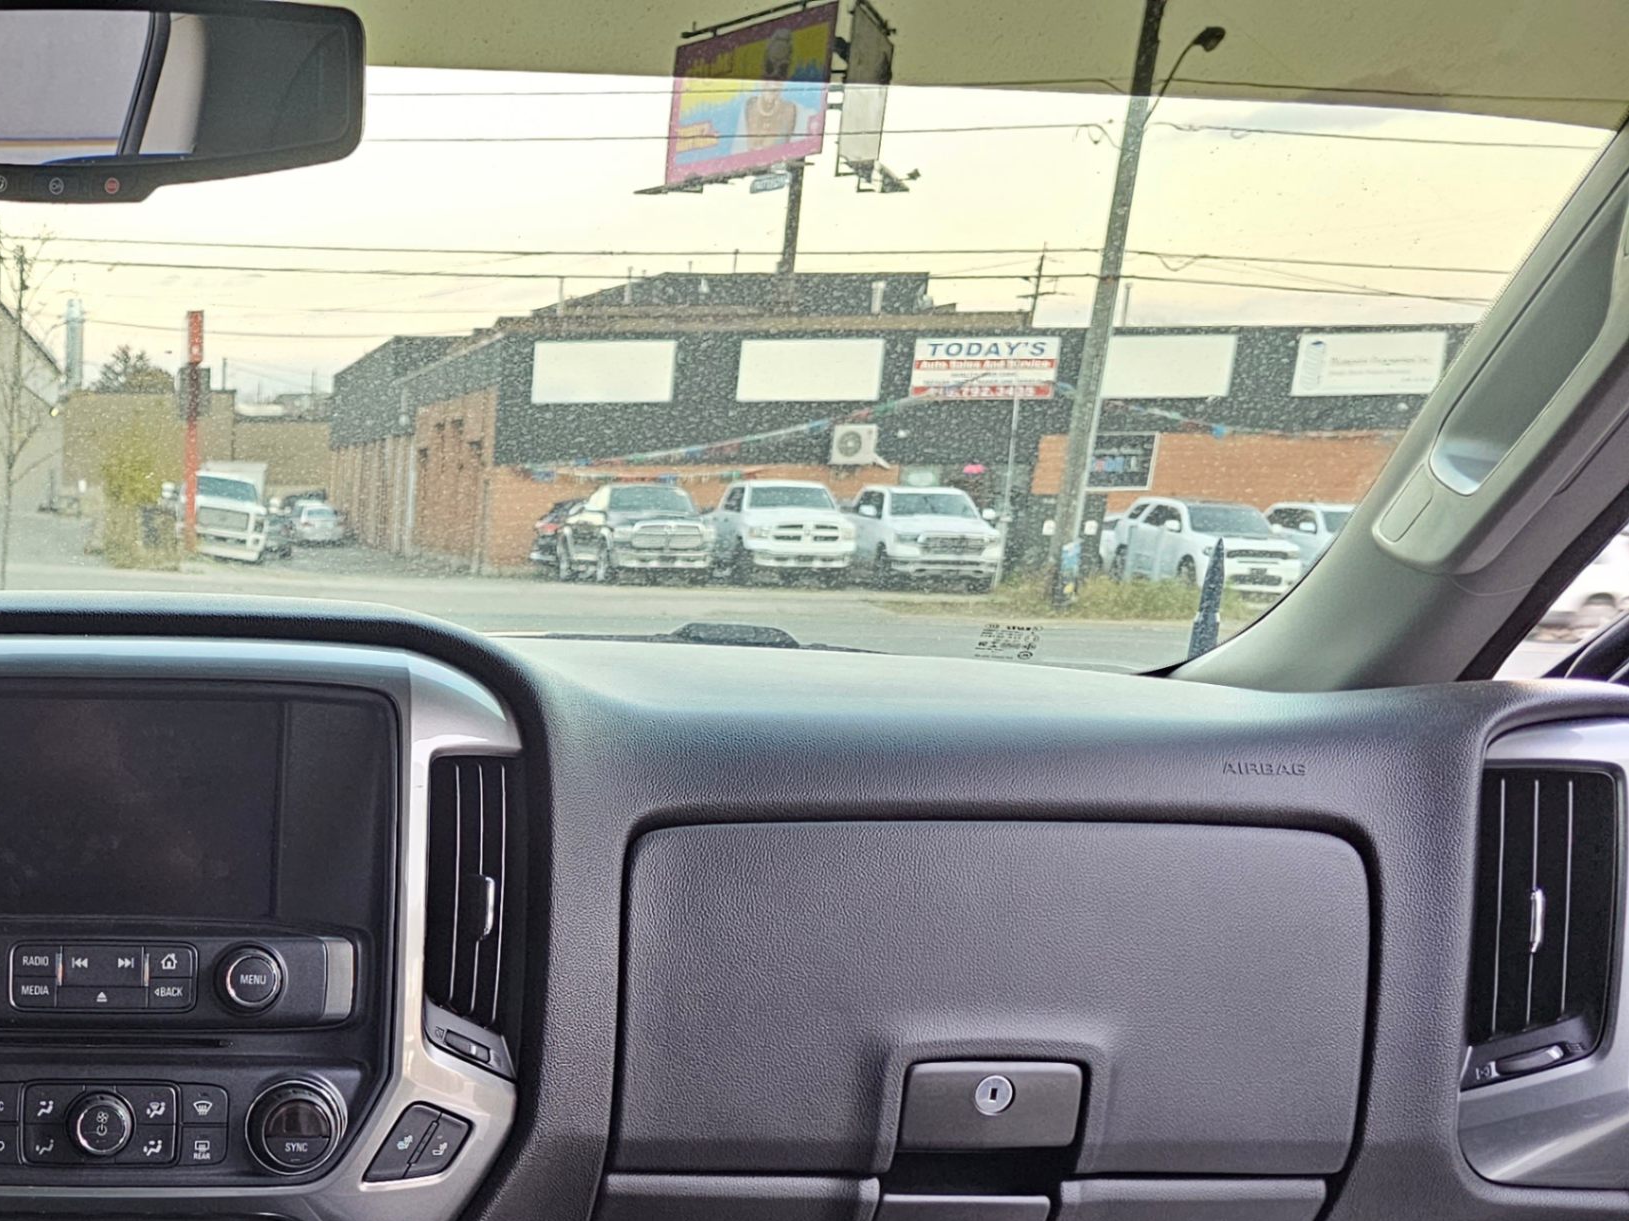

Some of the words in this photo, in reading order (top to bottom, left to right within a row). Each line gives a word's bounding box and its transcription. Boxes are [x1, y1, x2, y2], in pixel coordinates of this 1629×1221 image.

[928, 341, 1047, 357] TODAY'S
[1222, 761, 1307, 777] AIRBAG
[22, 955, 49, 967] RADIO
[239, 974, 267, 985] MENU
[21, 985, 50, 996] MEDIA
[160, 987, 183, 998] BACK
[284, 1142, 309, 1153] SYNC
[193, 1152, 211, 1160] REAR
